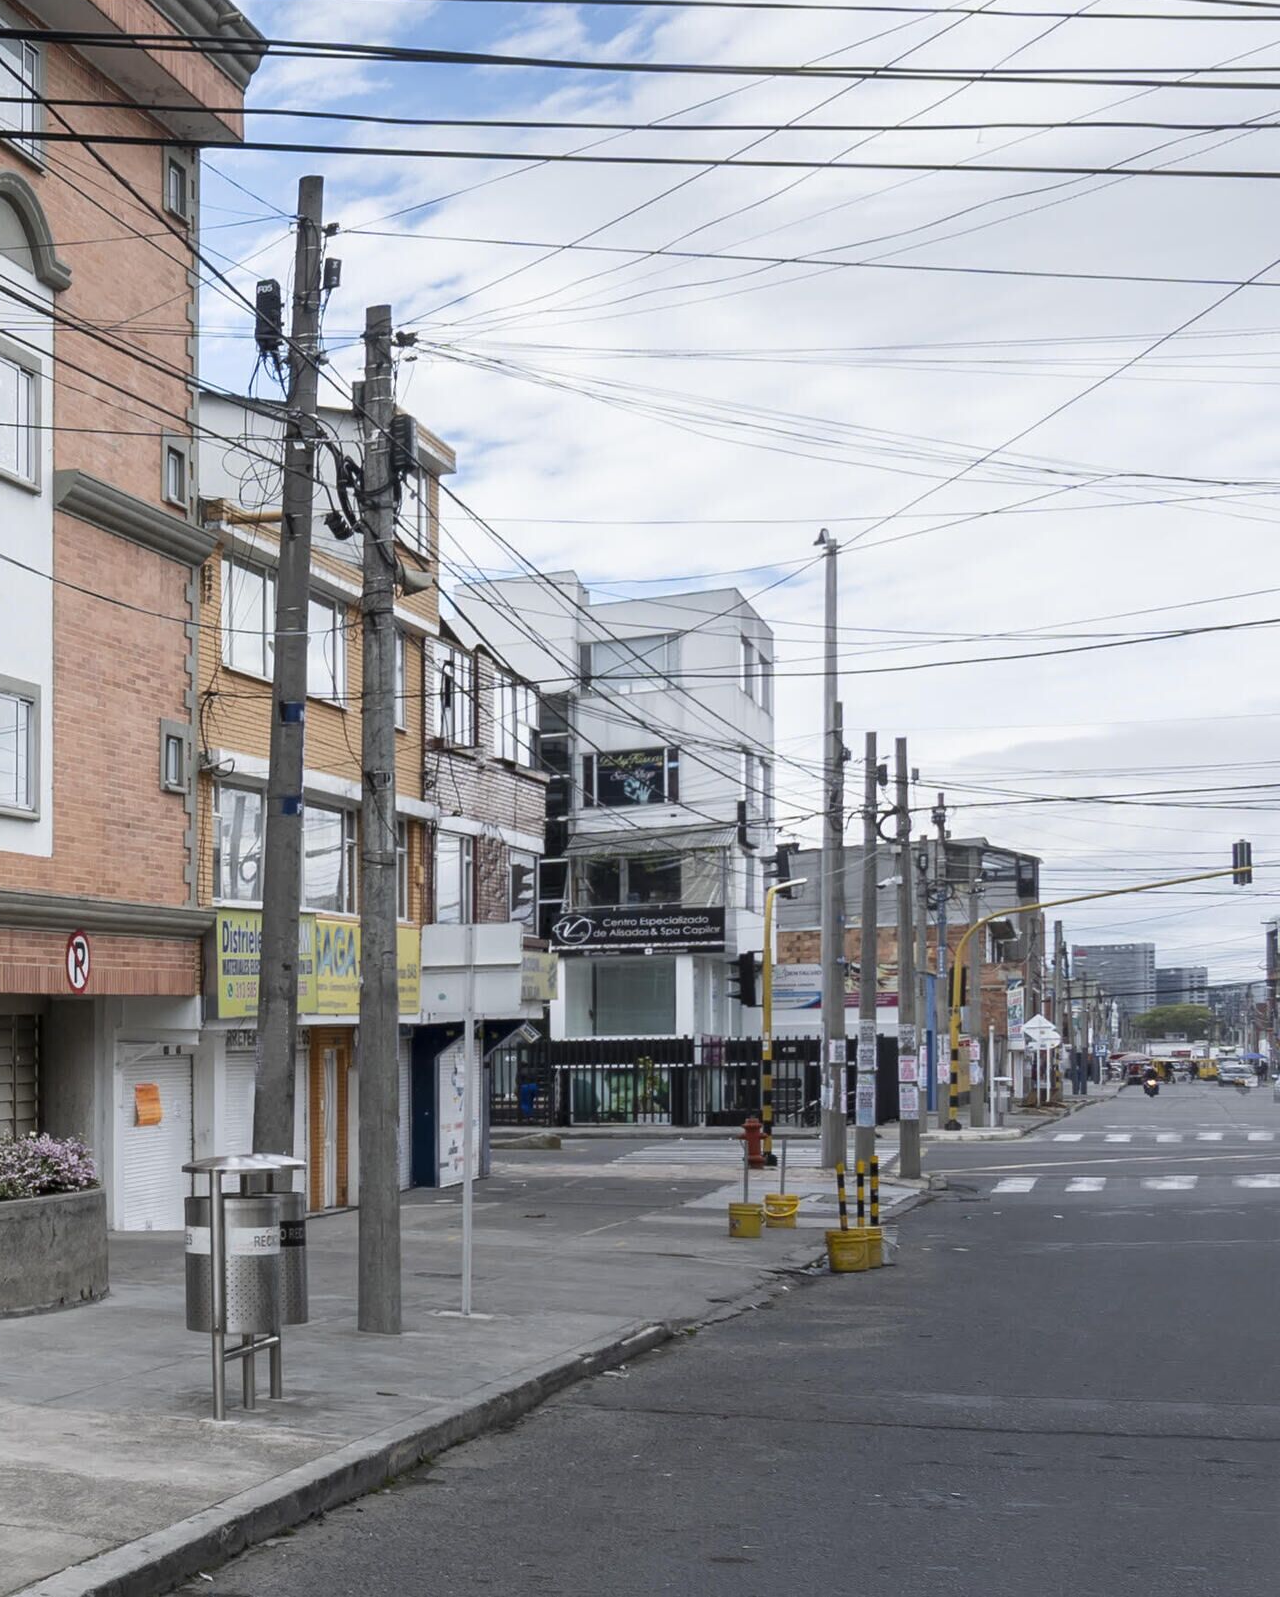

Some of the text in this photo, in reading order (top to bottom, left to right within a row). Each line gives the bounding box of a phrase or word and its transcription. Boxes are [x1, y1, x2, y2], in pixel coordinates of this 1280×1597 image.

[602, 915, 709, 927] Centro Especializado
[593, 930, 607, 938] de
[609, 928, 649, 937] Alisados
[660, 926, 681, 937] Spa
[682, 925, 721, 935] Capilar
